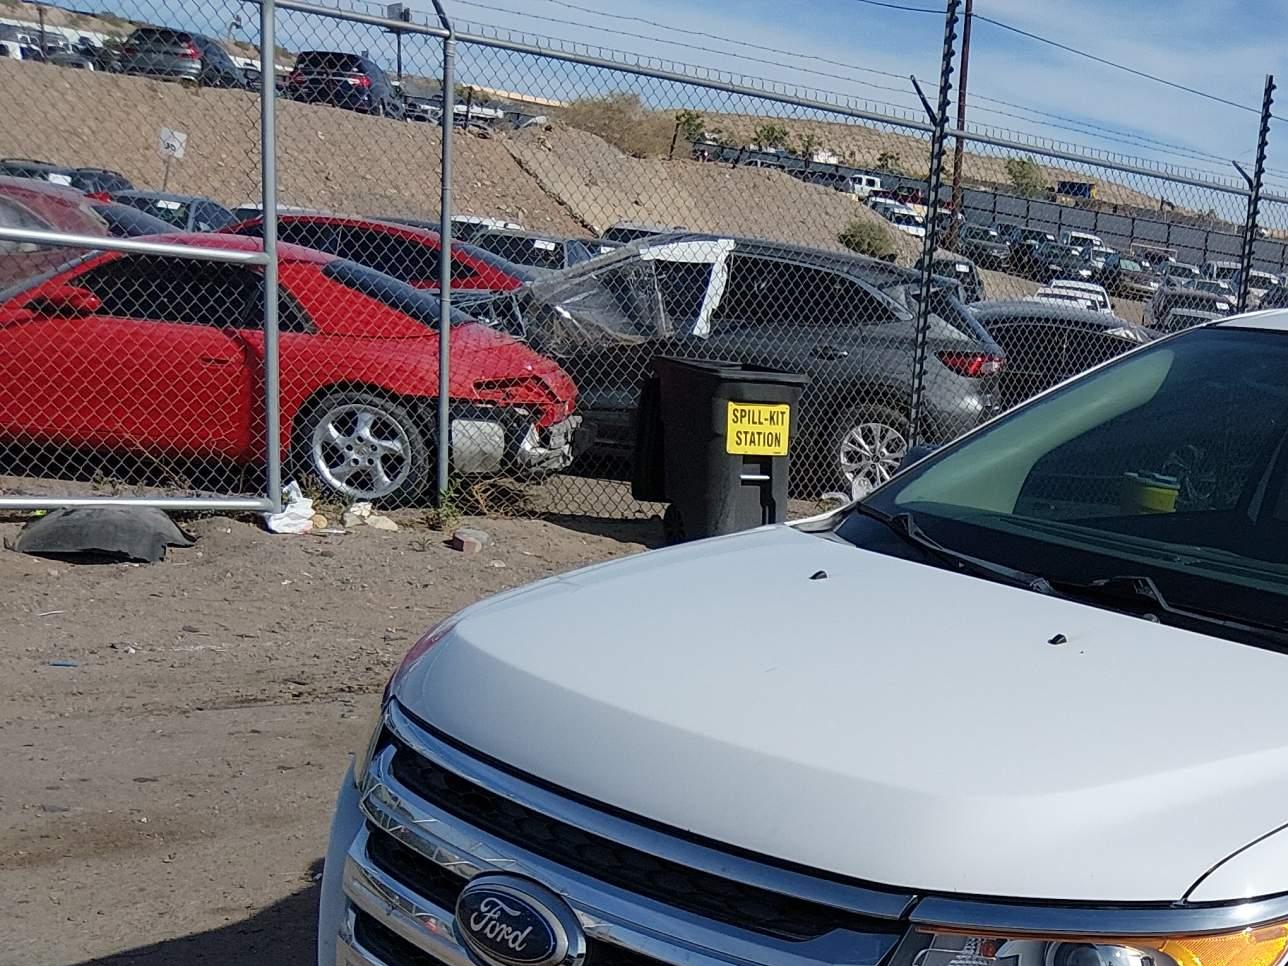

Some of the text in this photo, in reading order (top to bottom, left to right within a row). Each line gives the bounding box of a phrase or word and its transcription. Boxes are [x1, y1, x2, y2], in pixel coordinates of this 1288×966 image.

[732, 408, 786, 426] SPILL-KIT
[735, 430, 781, 447] STATION
[470, 897, 533, 951] Ford
